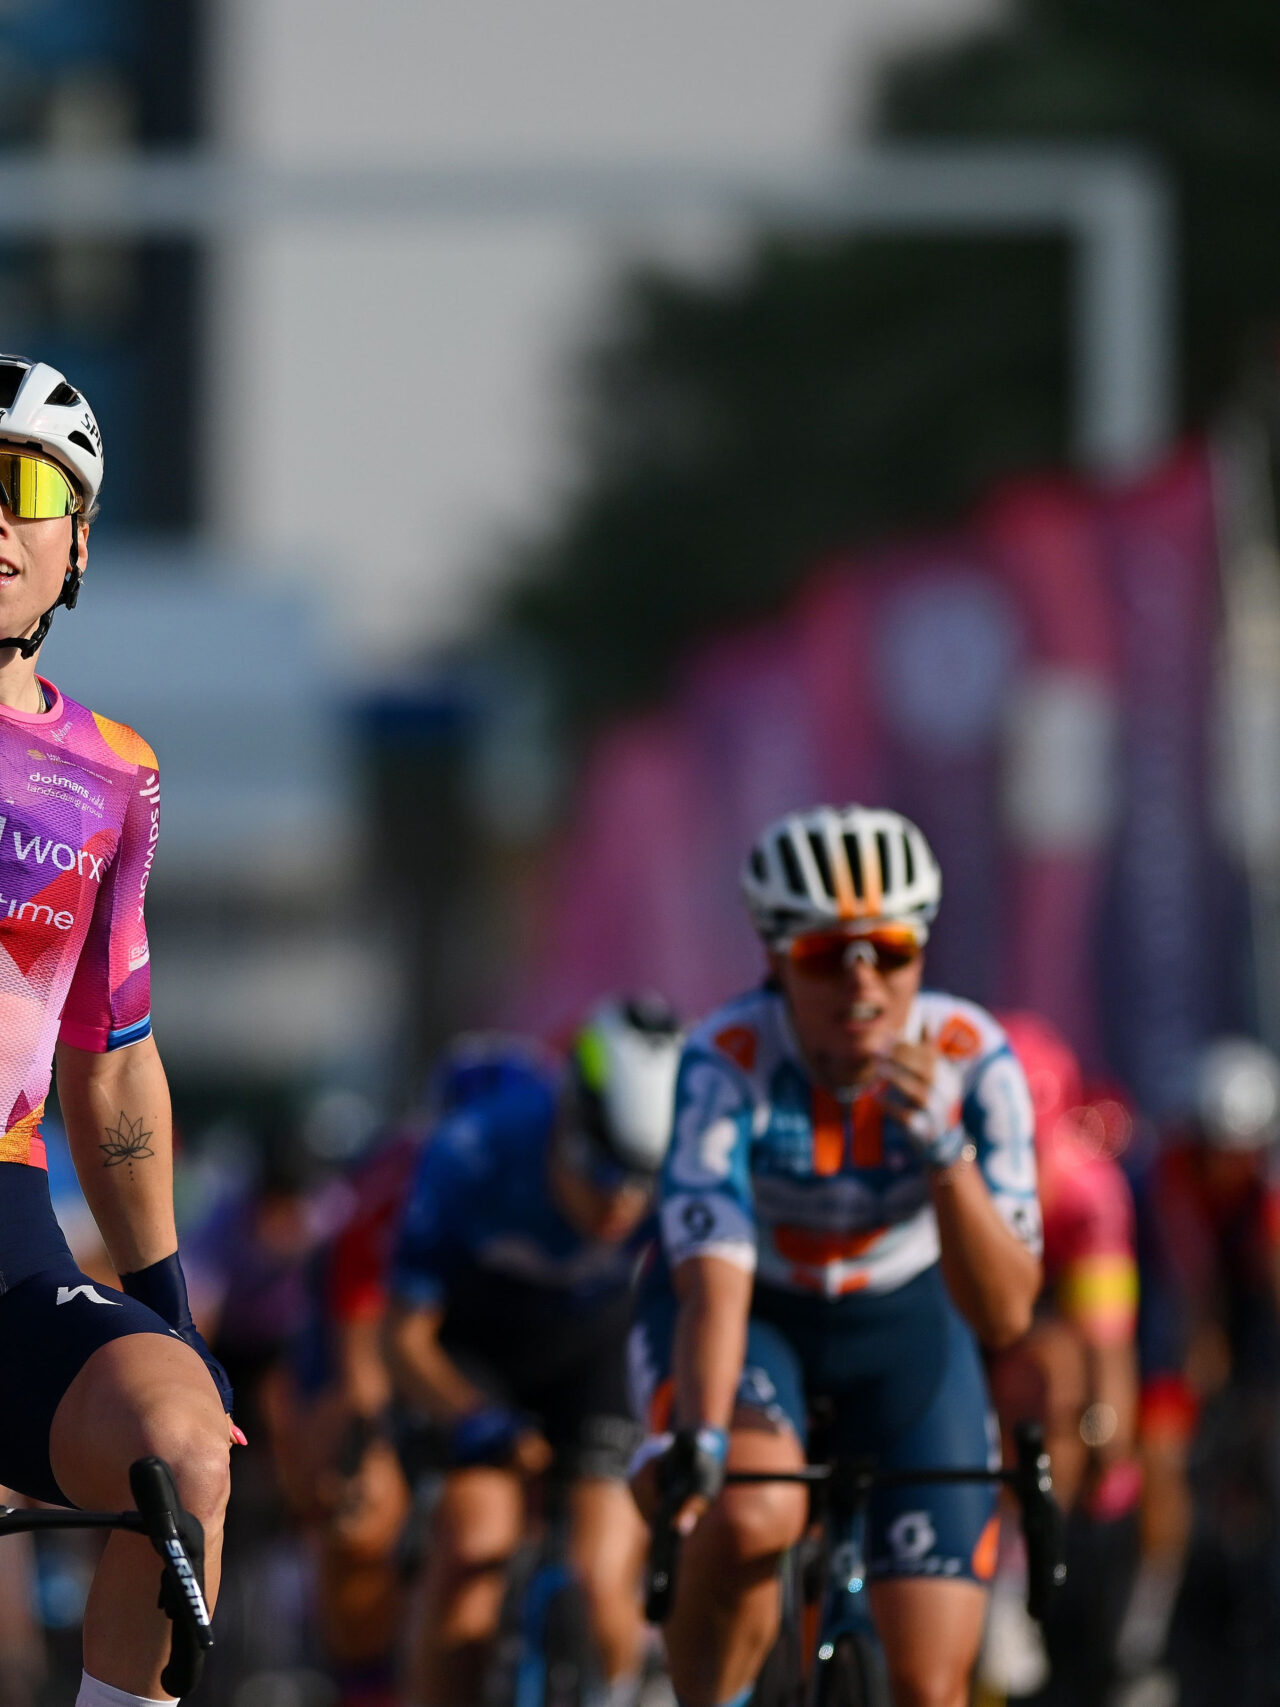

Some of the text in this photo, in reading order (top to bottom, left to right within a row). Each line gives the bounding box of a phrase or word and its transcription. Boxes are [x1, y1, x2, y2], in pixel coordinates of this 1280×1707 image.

[29, 772, 90, 799] dolmans
[81, 803, 103, 819] group
[165, 1539, 210, 1626] SRAM
